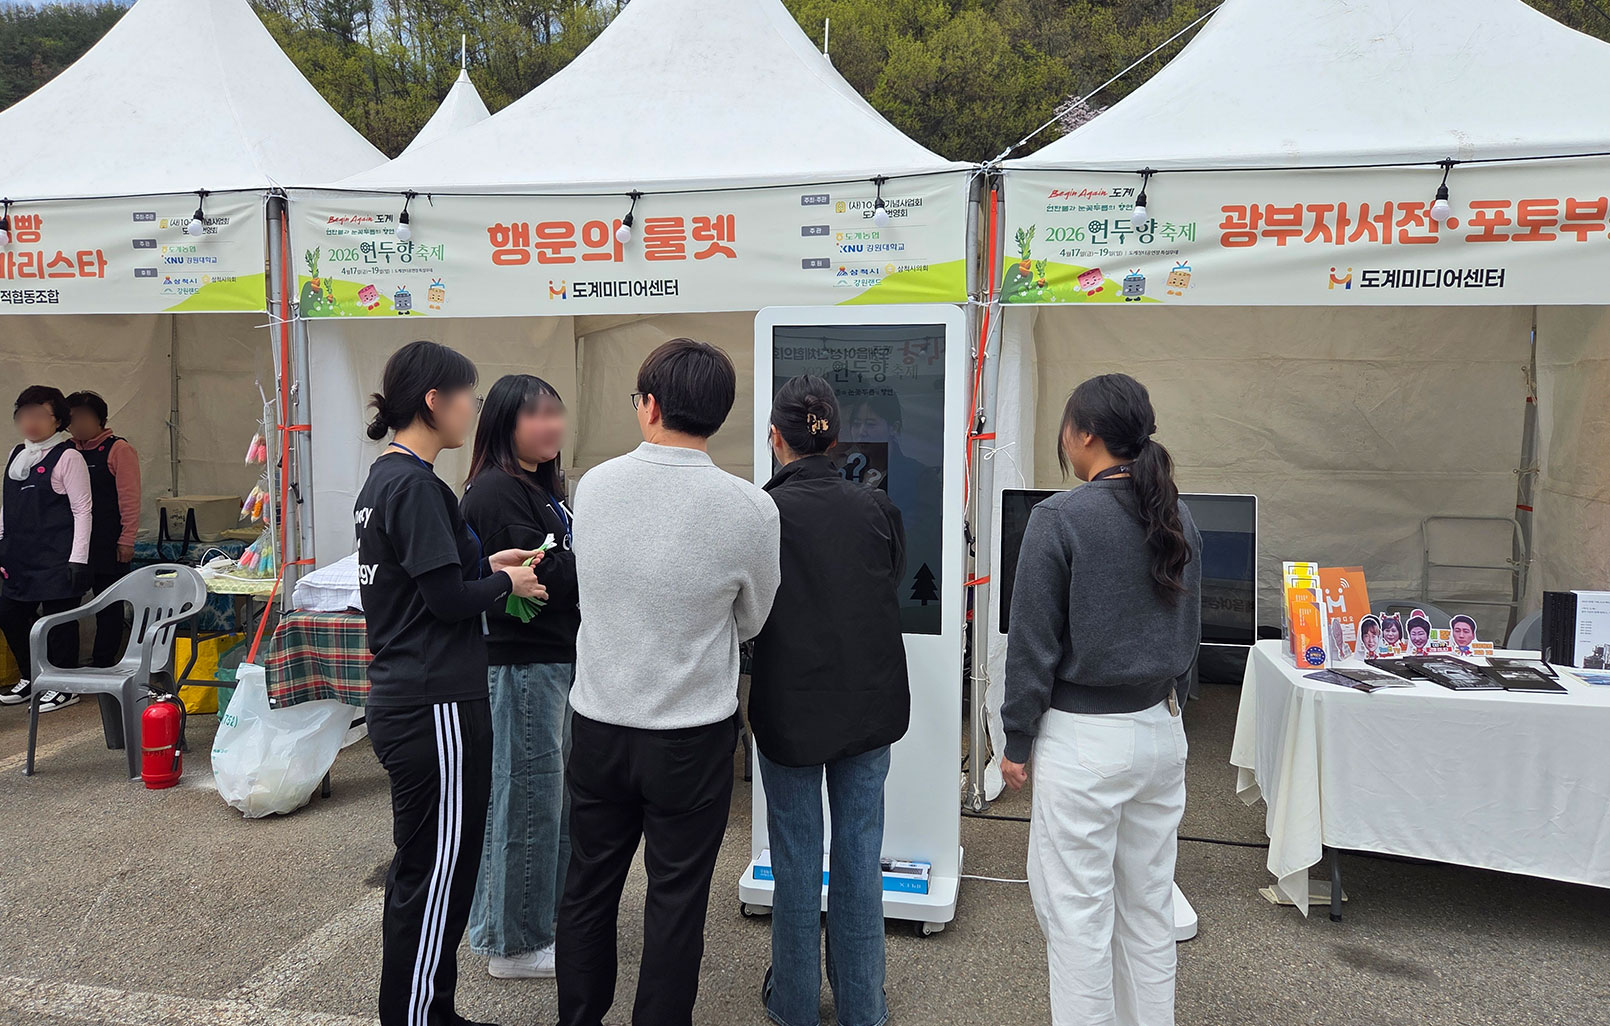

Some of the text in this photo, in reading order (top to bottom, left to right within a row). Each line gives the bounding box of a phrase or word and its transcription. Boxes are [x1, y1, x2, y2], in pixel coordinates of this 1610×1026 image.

[1048, 187, 1135, 200] Begin Again 도계
[327, 213, 394, 226] Begin Again 도계
[487, 213, 738, 266] 행운의 룰렛
[845, 231, 880, 240] 도계농협
[1045, 227, 1085, 242] 2026
[840, 242, 905, 253] KNU 강원대학교
[165, 256, 218, 264] KNU 강원대학교
[328, 248, 359, 262] 2026
[849, 264, 929, 276] 삼척시 삼척시의회
[174, 277, 199, 286] 삼척시
[853, 278, 883, 287] 강원랜드
[1360, 268, 1505, 289] 도계미디어센터
[572, 279, 679, 299] 도계미디어센터
